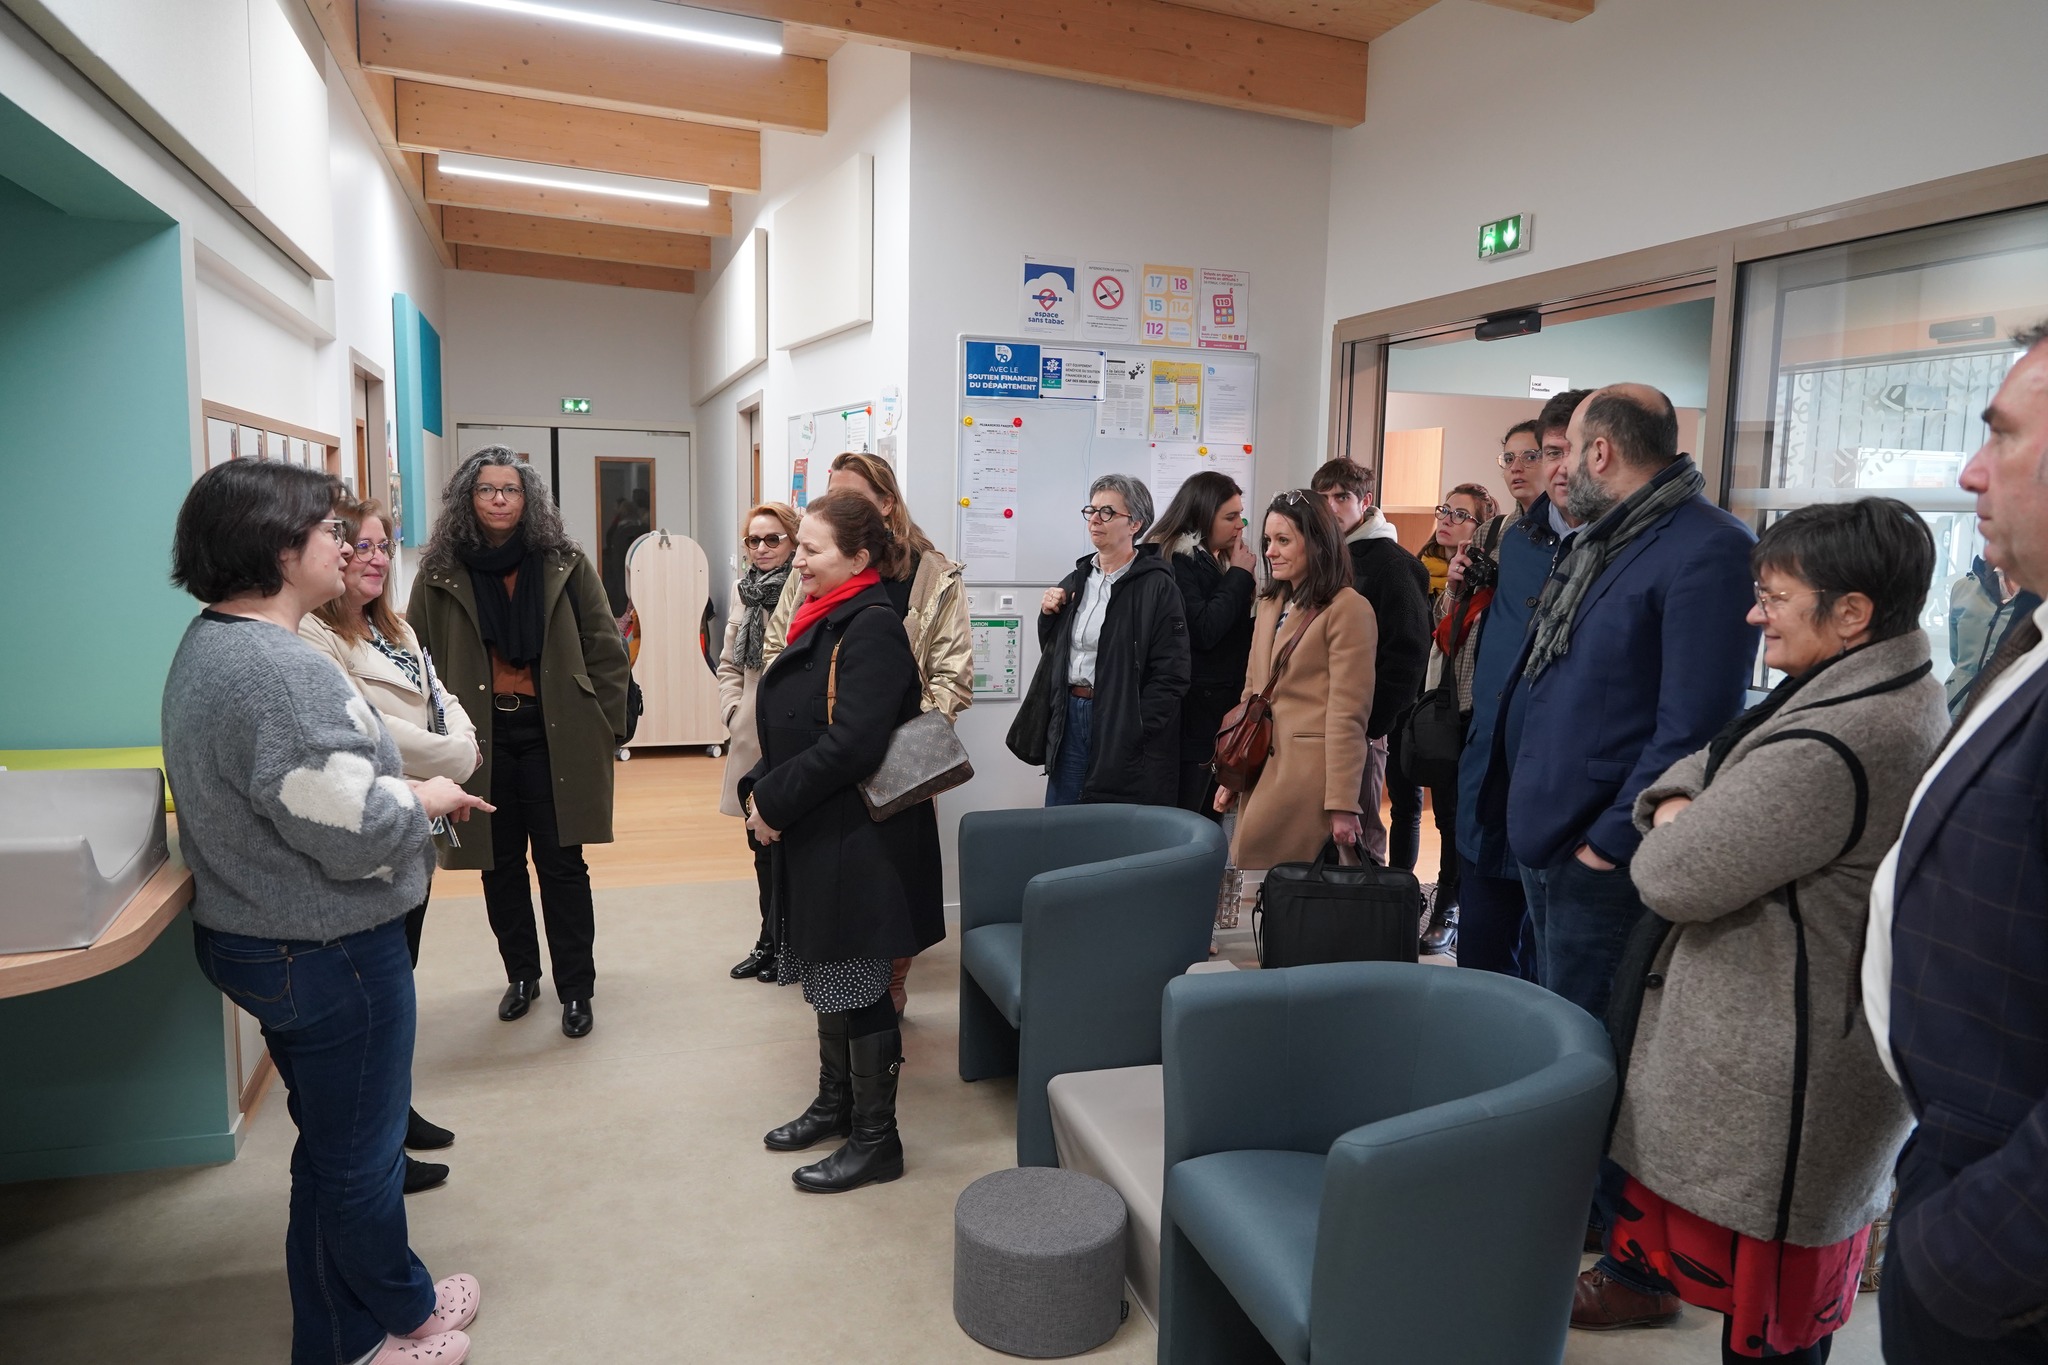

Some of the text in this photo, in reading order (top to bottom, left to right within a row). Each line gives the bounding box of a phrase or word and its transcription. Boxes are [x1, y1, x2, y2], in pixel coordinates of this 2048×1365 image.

[1150, 275, 1162, 288] 17
[1174, 278, 1188, 290] 18
[1149, 299, 1162, 312] 15
[1171, 301, 1189, 313] 114
[1216, 298, 1230, 306] 119
[1034, 311, 1058, 319] espace
[1045, 317, 1064, 325] tabac
[1146, 322, 1163, 335] 112
[997, 353, 1008, 362] 79
[968, 373, 1038, 383] SOUTIEN FINANCIER
[983, 381, 1037, 390] DÉPARTEMENT
